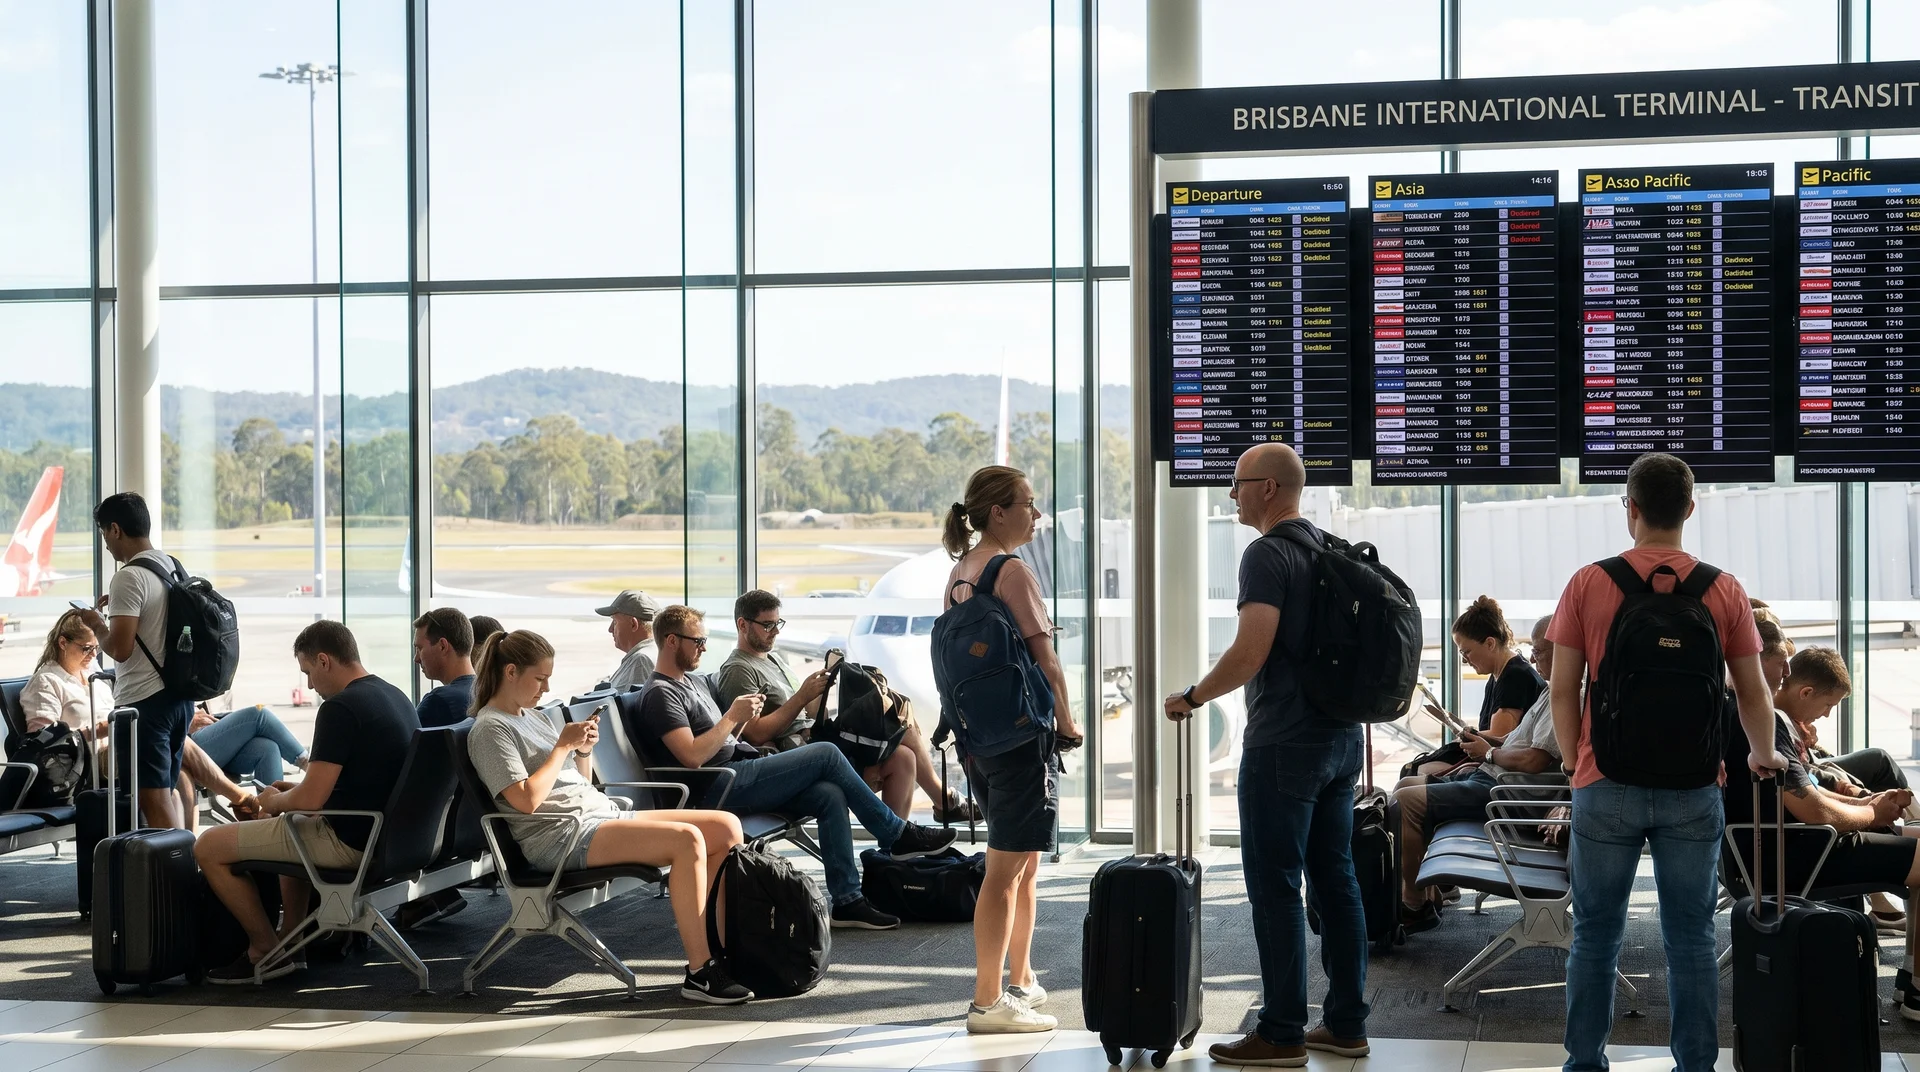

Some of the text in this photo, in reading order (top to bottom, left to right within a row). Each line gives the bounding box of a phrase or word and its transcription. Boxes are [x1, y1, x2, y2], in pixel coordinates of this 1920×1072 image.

[1234, 104, 1366, 130] BRISBANE
[1378, 96, 1606, 125] INTERNATIONAL
[1614, 89, 1765, 116] TERMINAL
[1793, 83, 1919, 110] TRANSIT
[1645, 174, 1690, 187] Pacific
[1823, 168, 1870, 182] Pacific
[1395, 183, 1424, 195] Asia
[1192, 189, 1263, 204] Departure
